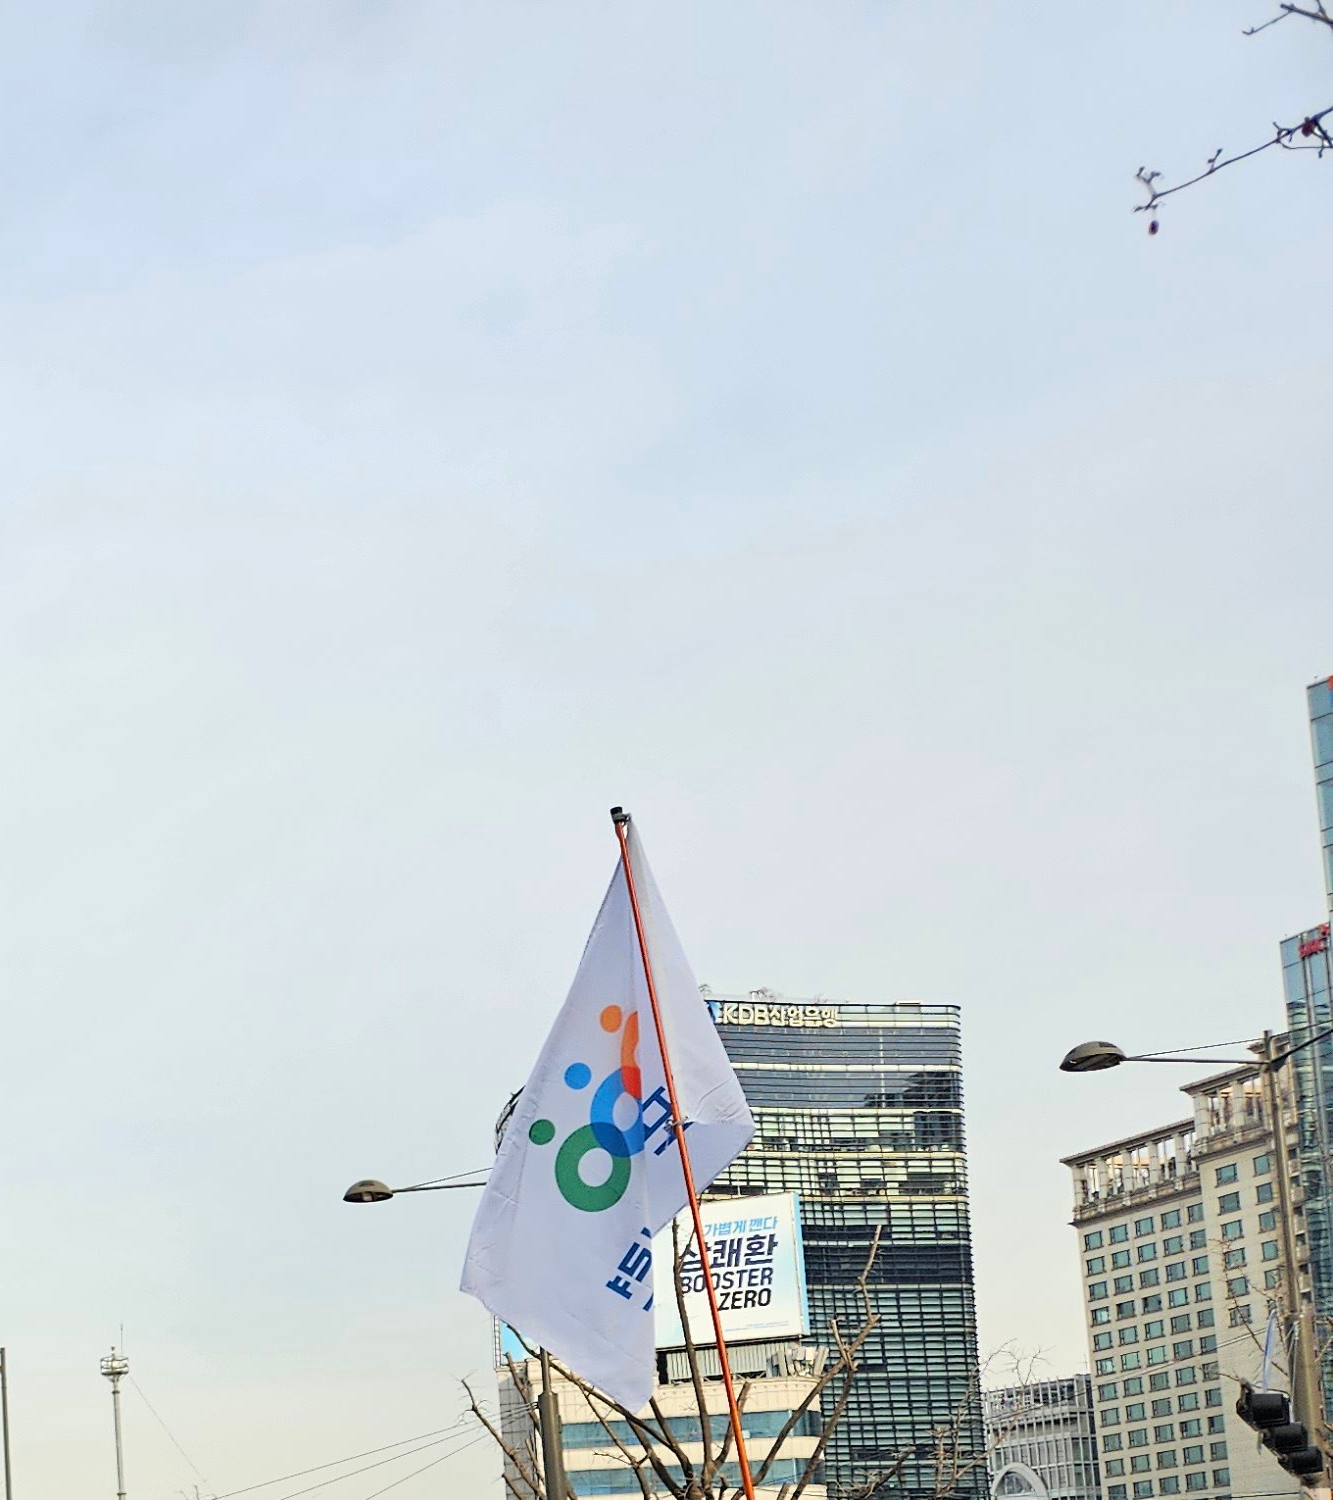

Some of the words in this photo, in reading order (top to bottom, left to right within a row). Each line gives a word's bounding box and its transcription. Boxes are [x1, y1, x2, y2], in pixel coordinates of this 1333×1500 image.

[722, 1003, 838, 1027] KDB산업은행
[704, 1219, 746, 1237] 가볍게
[681, 1267, 774, 1294] BOOSTER
[717, 1288, 772, 1311] ZERO
